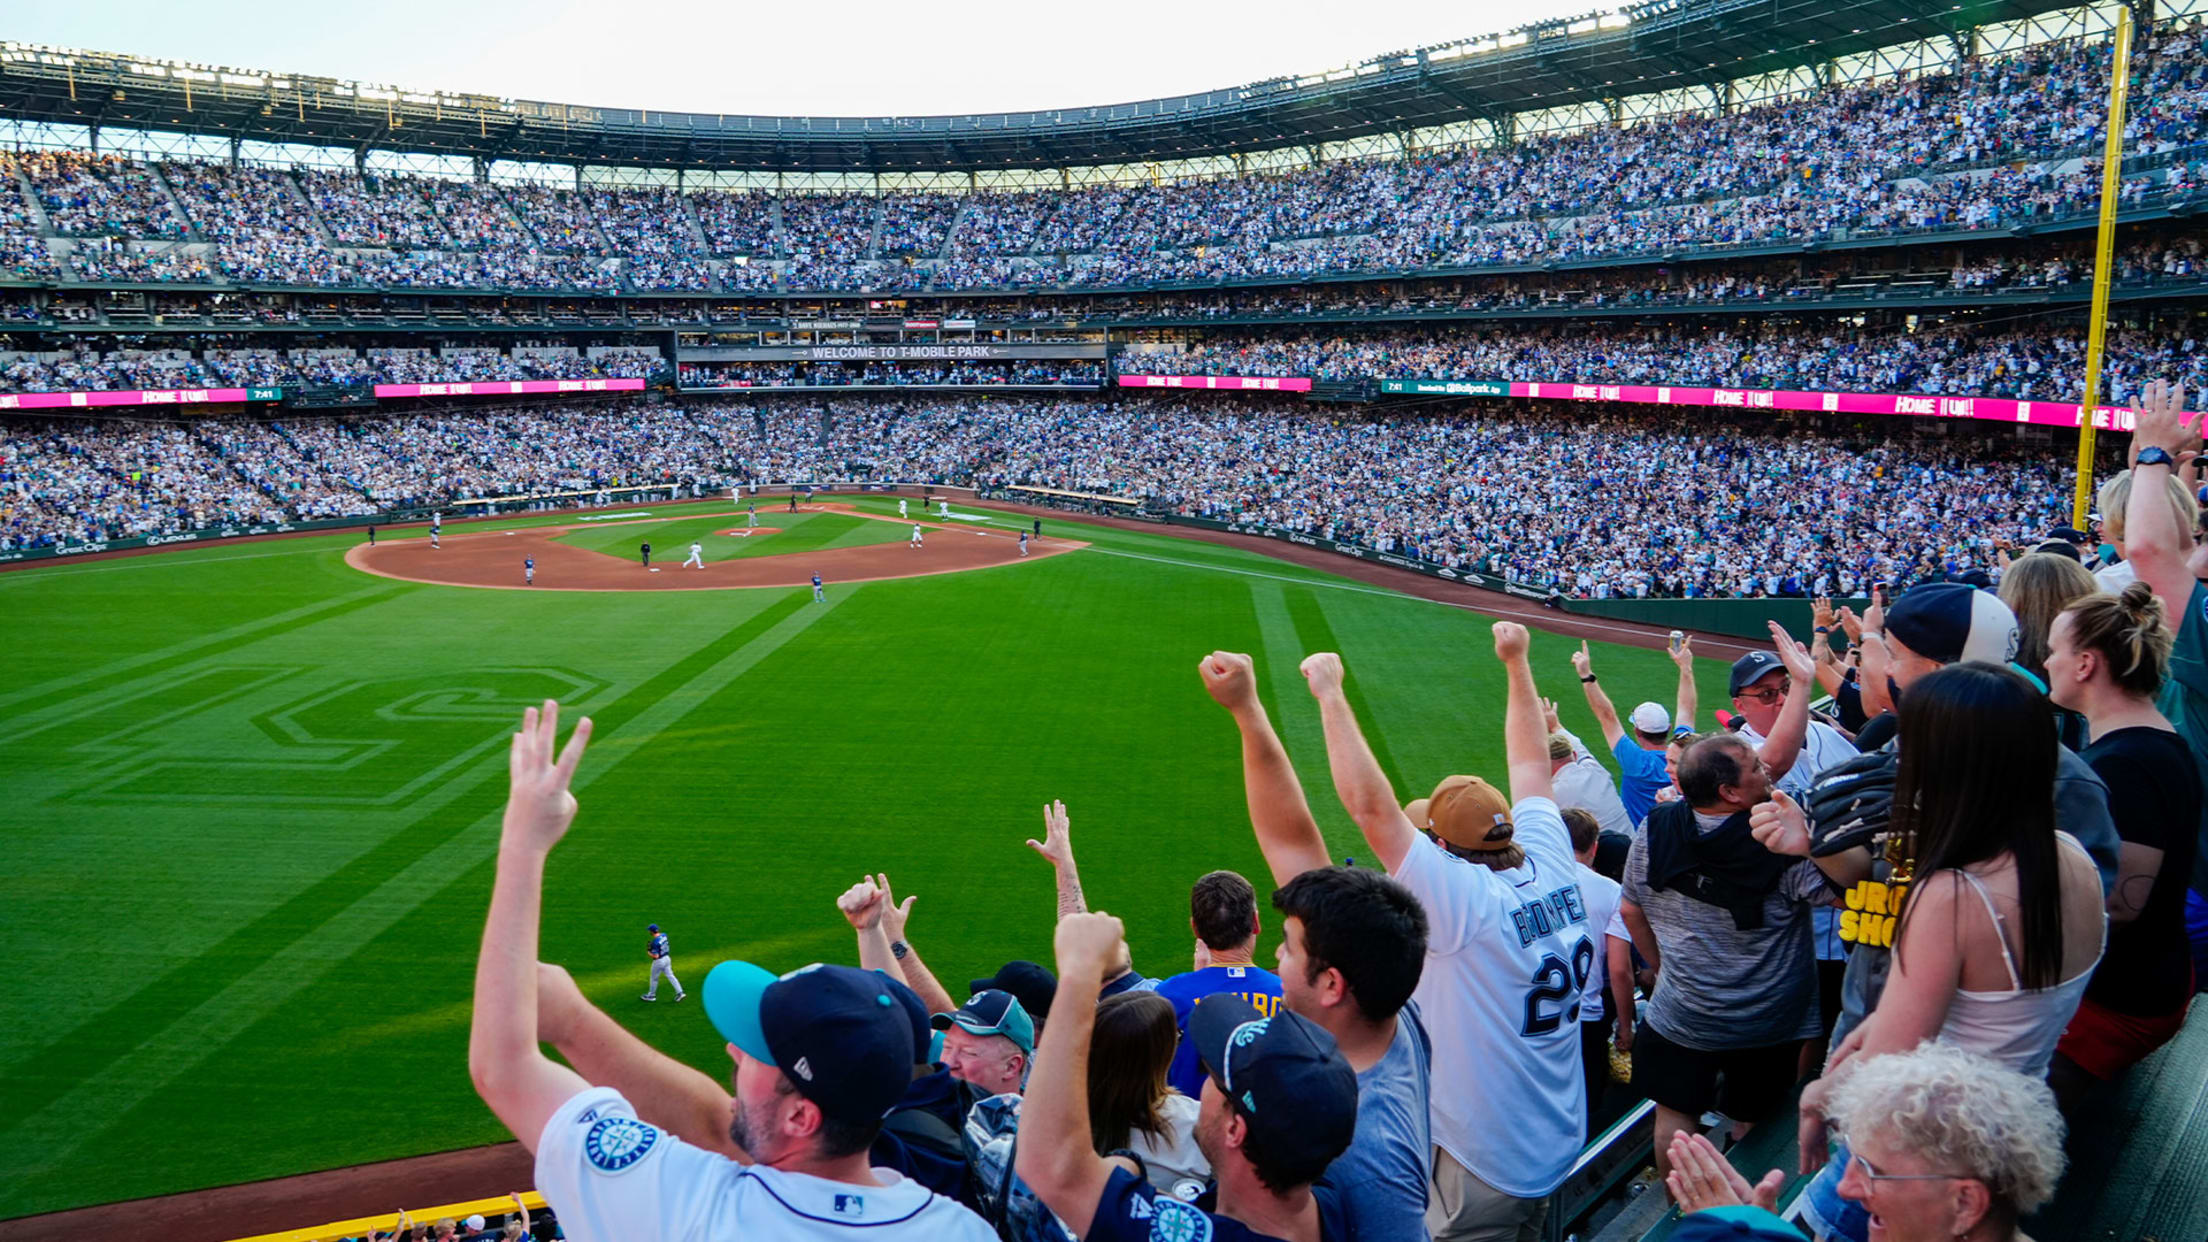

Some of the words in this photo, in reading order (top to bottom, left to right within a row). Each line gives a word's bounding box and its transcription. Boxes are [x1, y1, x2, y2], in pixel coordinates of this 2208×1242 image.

[812, 346, 876, 358] WELCOME
[880, 346, 896, 358] TO
[900, 345, 956, 358] T-MOBILE
[958, 344, 990, 358] PARK
[254, 390, 273, 398] 7:41
[1388, 383, 1402, 391] 7:41
[1712, 390, 1744, 405] HOME
[1894, 396, 1936, 414] HOME
